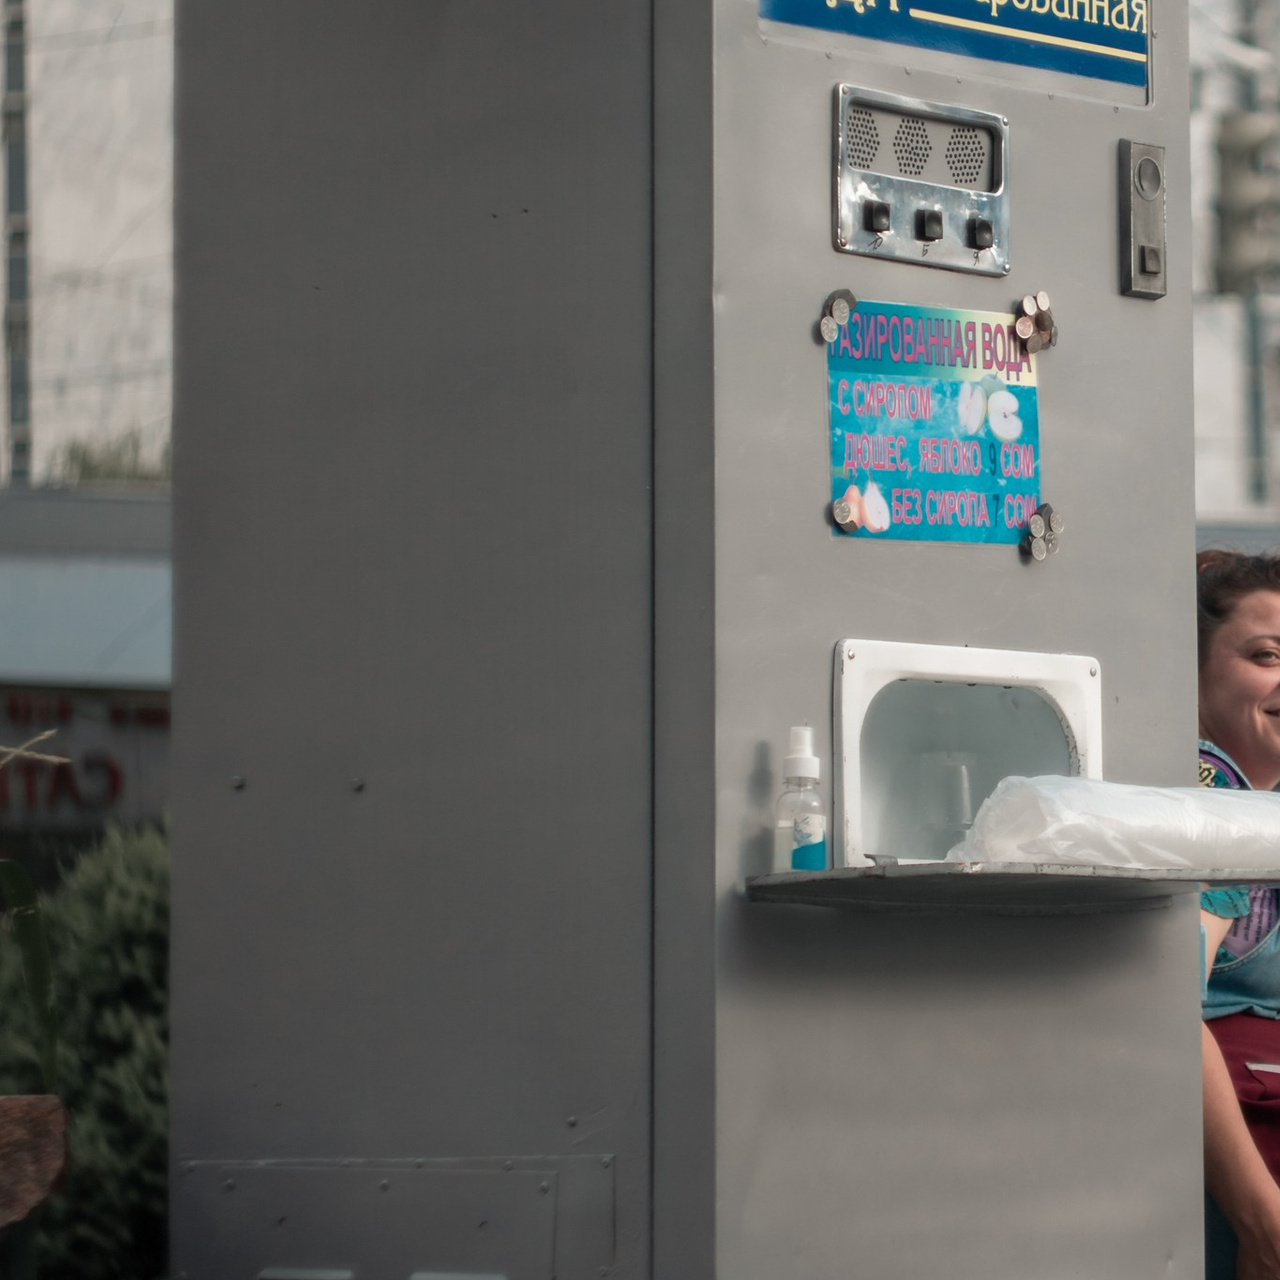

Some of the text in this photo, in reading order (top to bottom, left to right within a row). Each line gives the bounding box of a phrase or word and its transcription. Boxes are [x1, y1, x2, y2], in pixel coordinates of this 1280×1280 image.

[838, 379, 932, 420] С СИРОПОМ
[843, 434, 1034, 478] ДЮШЕС, ЯБЛОКО 9 СОМ
[892, 488, 1037, 529] БЕЗ СИРОПА 7 СОМ
